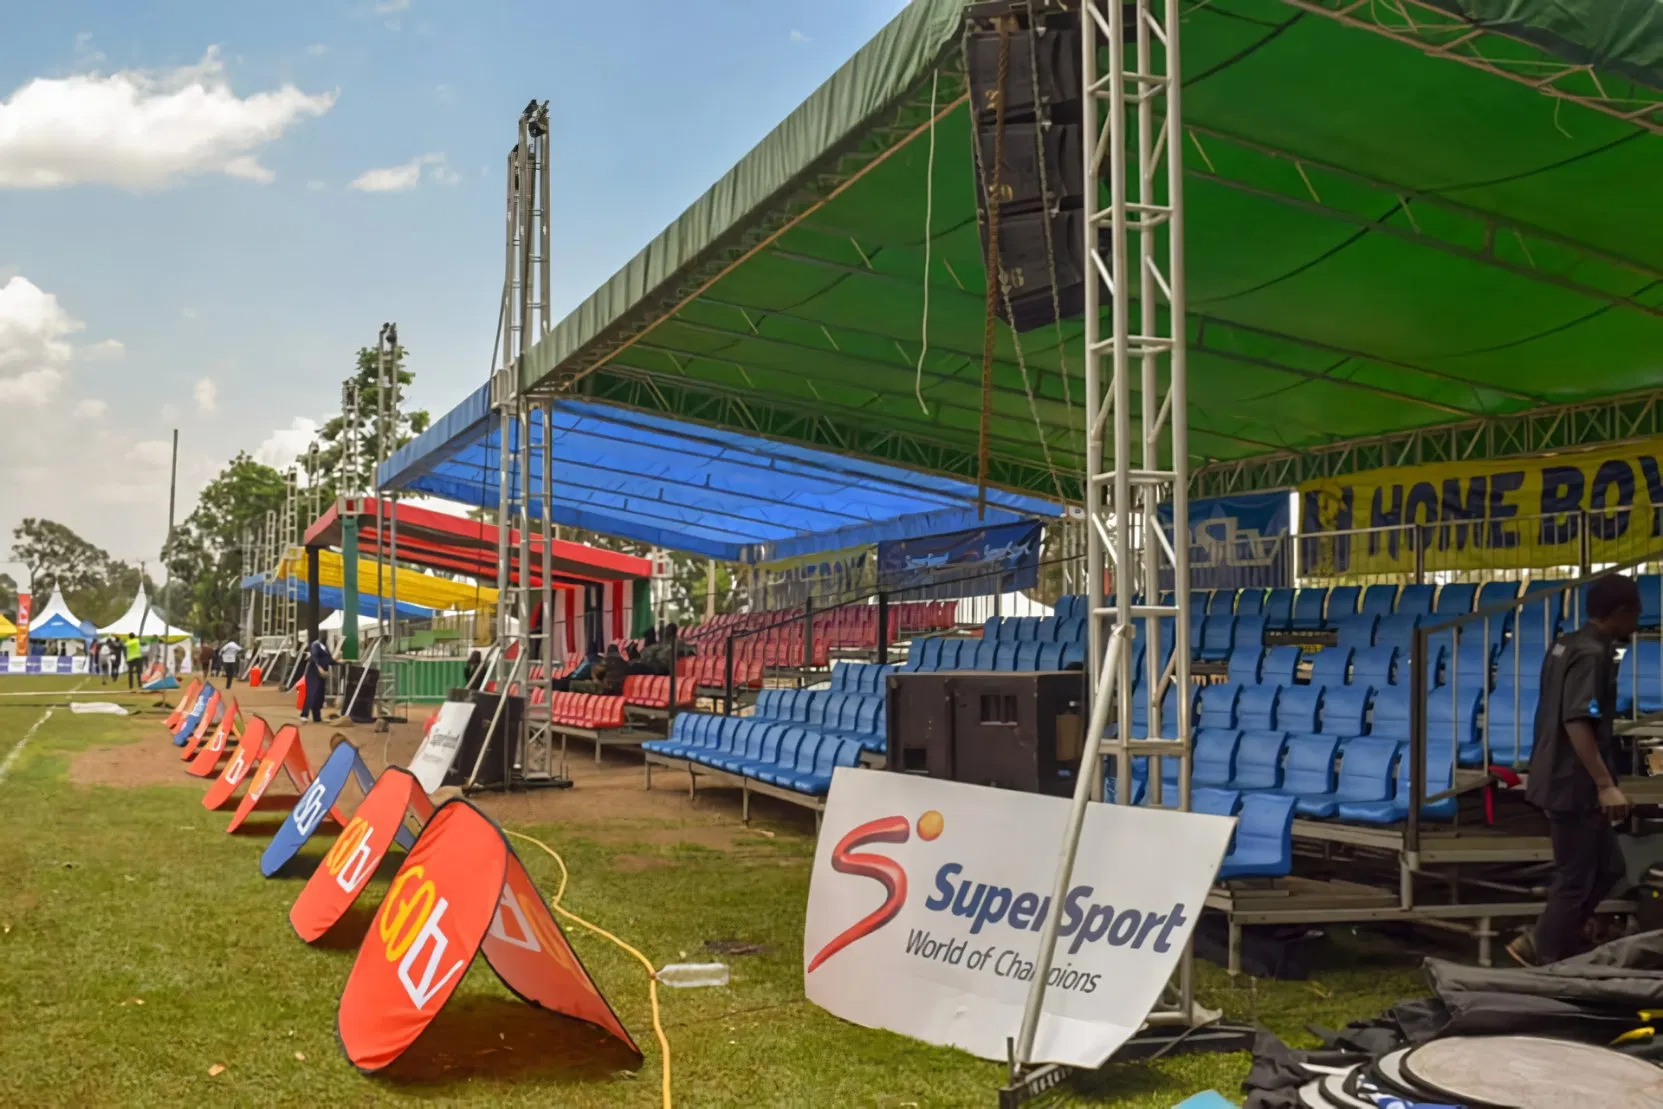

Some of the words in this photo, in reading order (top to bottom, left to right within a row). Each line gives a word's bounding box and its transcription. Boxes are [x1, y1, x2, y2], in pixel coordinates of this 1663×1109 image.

[1368, 471, 1526, 560] HOME
[906, 929, 968, 965] World
[967, 946, 996, 971] of
[994, 950, 1102, 993] Chapions
